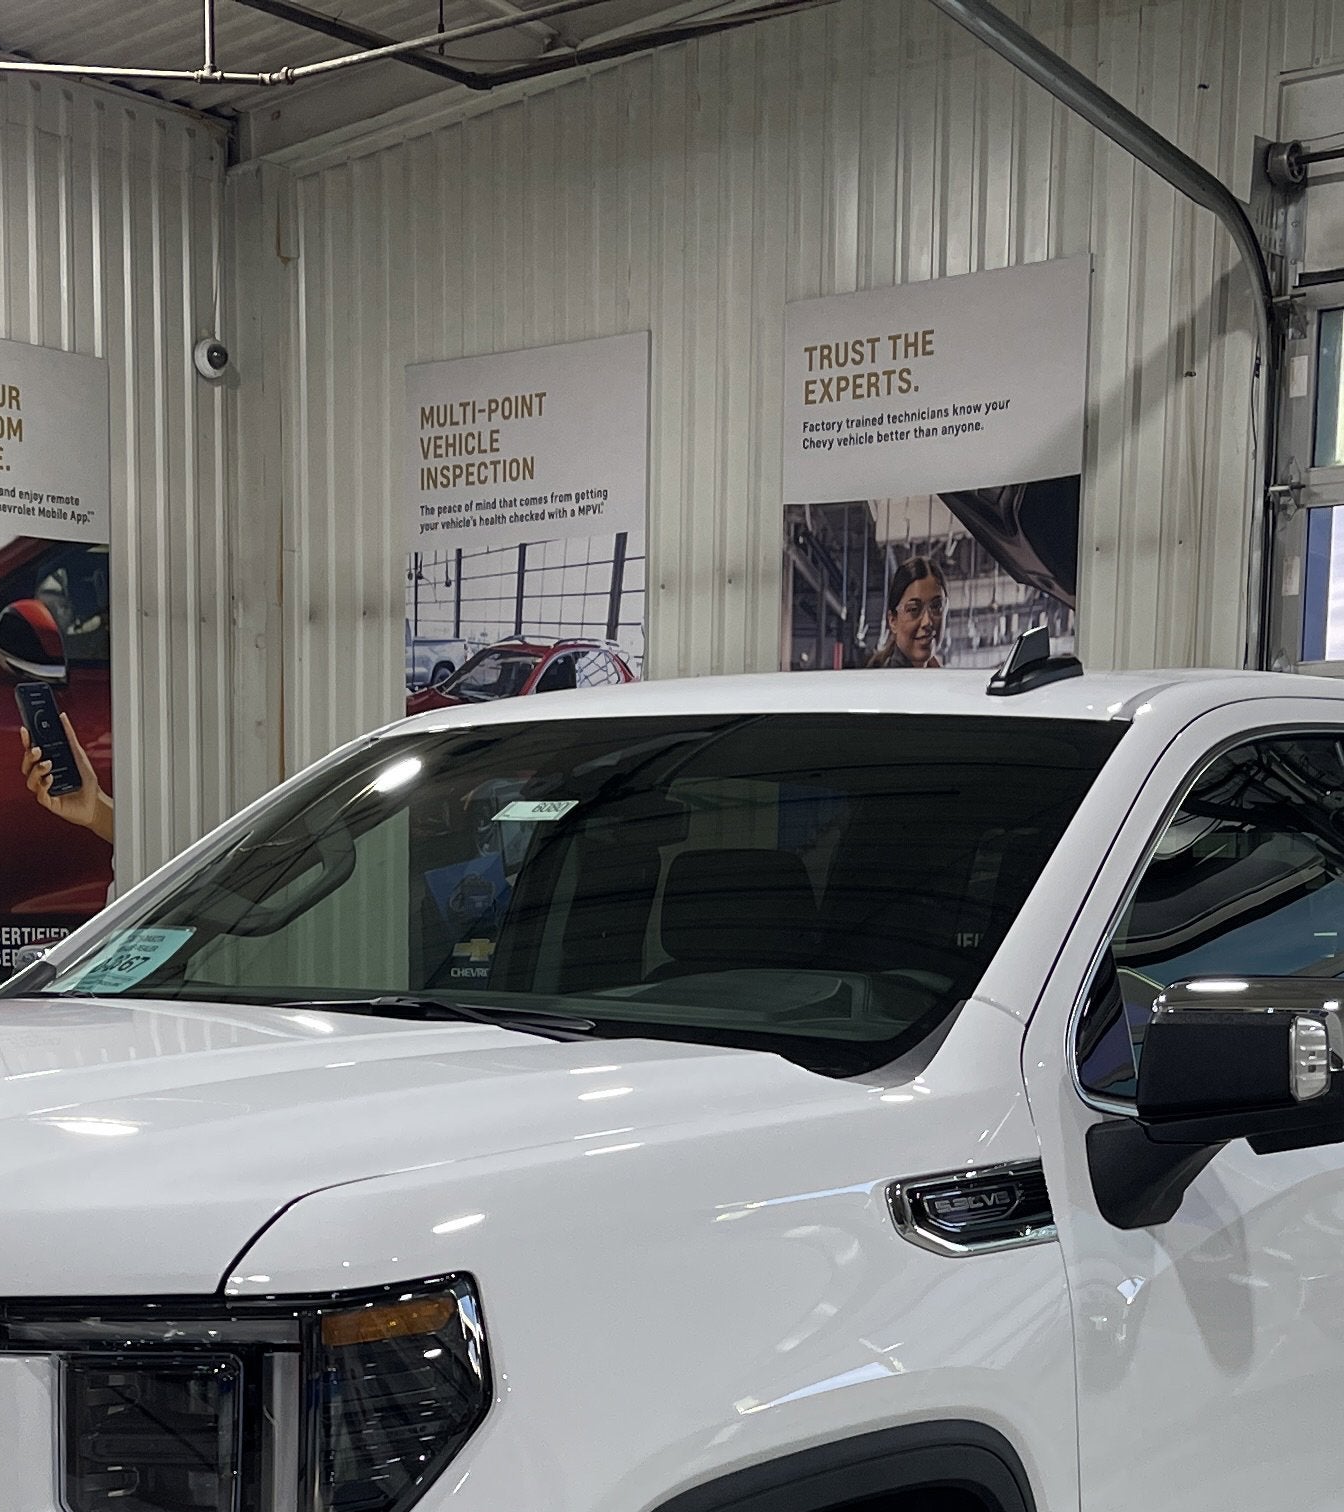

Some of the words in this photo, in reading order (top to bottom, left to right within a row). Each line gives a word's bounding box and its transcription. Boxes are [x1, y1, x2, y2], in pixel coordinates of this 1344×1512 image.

[804, 336, 880, 372] TRUST
[887, 329, 934, 361] THE
[804, 367, 919, 405] EXPERTS.
[421, 392, 547, 430] MULTI-POINT
[803, 419, 843, 434] Factory
[845, 413, 884, 429] trained
[887, 408, 949, 424] technicians
[952, 403, 981, 417] know
[985, 399, 1010, 415] your
[420, 429, 500, 460] VEHICLE
[803, 437, 834, 451] Chevy
[837, 432, 873, 447] vehicle
[876, 428, 910, 443] better
[913, 425, 938, 437] than
[941, 420, 984, 440] anyone.
[421, 456, 535, 490] INSPECTION
[0, 487, 15, 498] and
[19, 490, 44, 504] enjoy
[47, 494, 80, 506] remote
[420, 505, 435, 517] The
[437, 503, 462, 517] peace
[464, 501, 474, 512] of
[476, 499, 496, 512] mind
[499, 496, 517, 509] that
[519, 495, 548, 507] comes
[550, 491, 572, 504] from
[574, 488, 608, 506] getting
[38, 507, 67, 520] Mobile
[419, 520, 439, 534] your
[441, 515, 477, 531] vehicle's
[479, 513, 506, 526] health
[509, 510, 545, 524] checked
[547, 507, 567, 519] with
[570, 508, 576, 517] a
